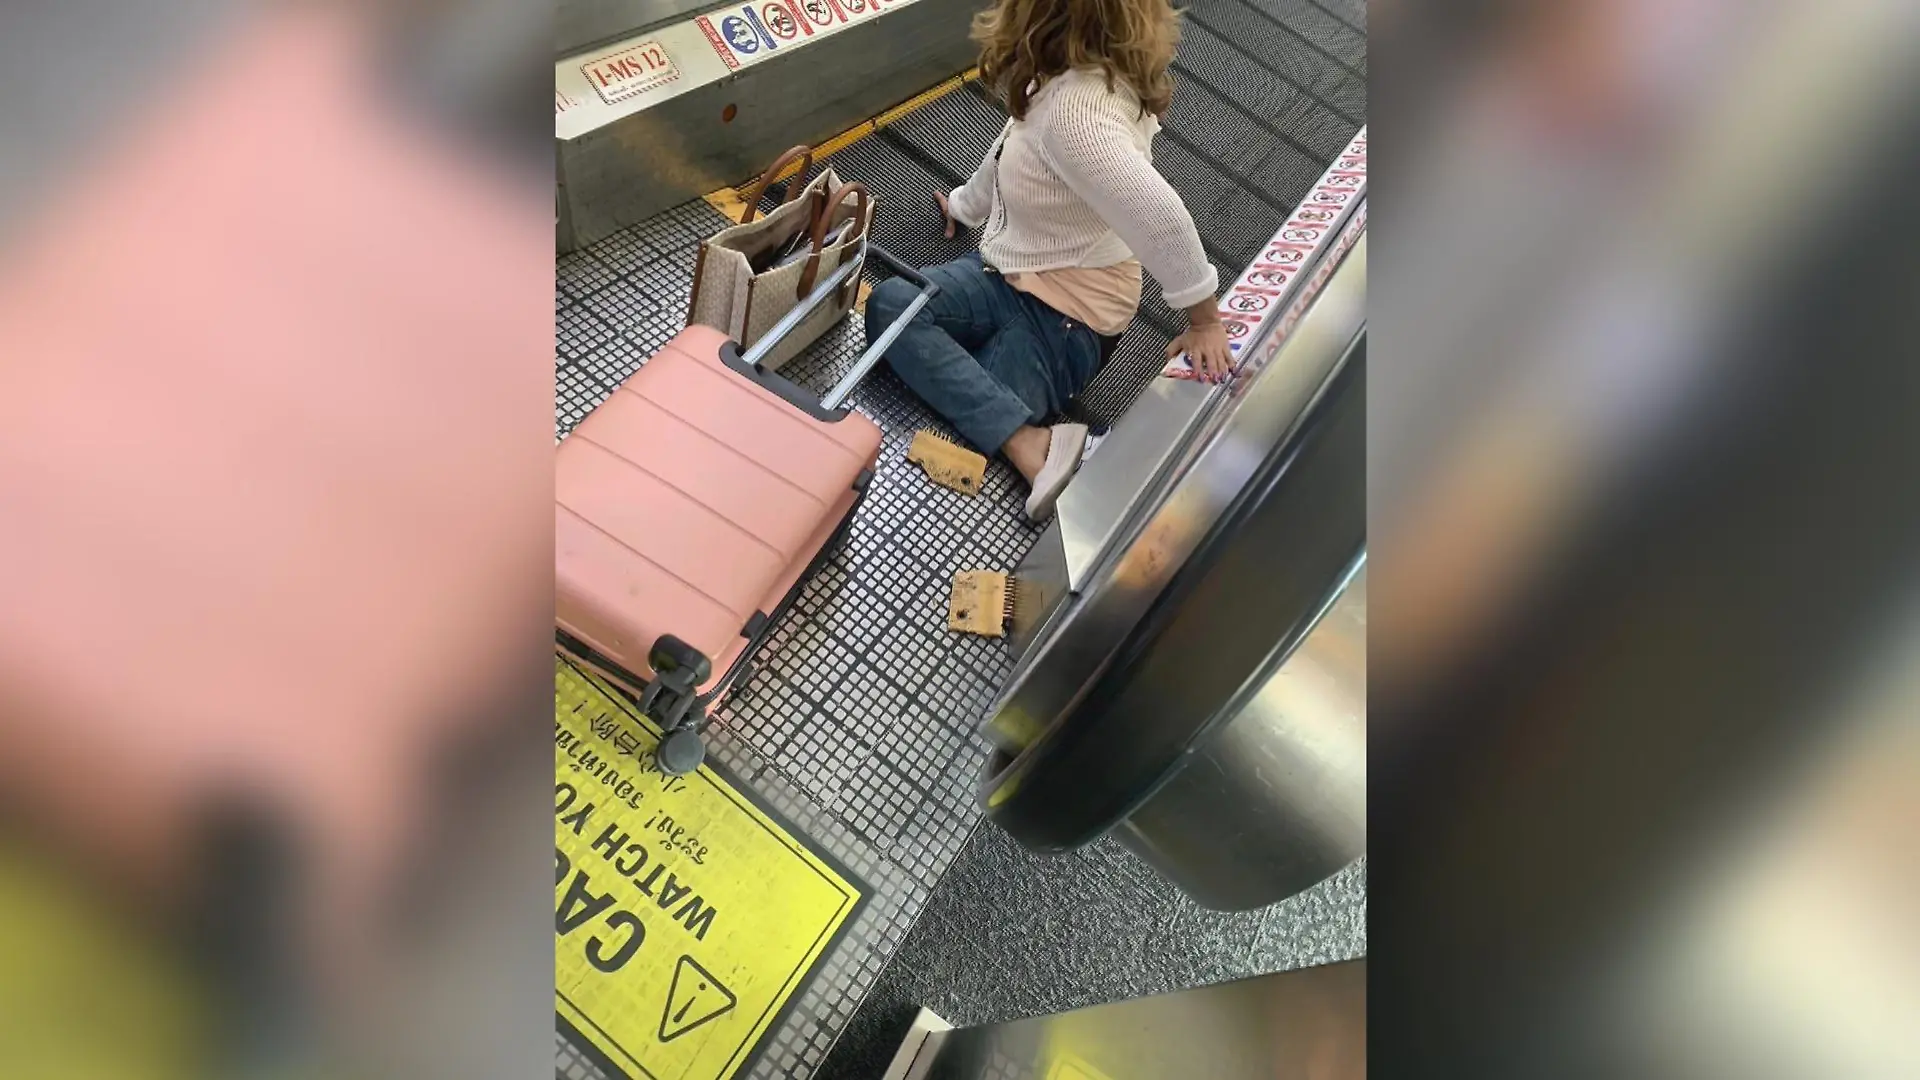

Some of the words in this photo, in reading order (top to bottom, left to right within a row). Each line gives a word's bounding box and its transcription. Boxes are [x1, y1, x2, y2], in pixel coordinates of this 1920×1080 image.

[641, 47, 666, 70] 12
[556, 722, 644, 810] รองเท้าข
[590, 822, 717, 942] WATCH
